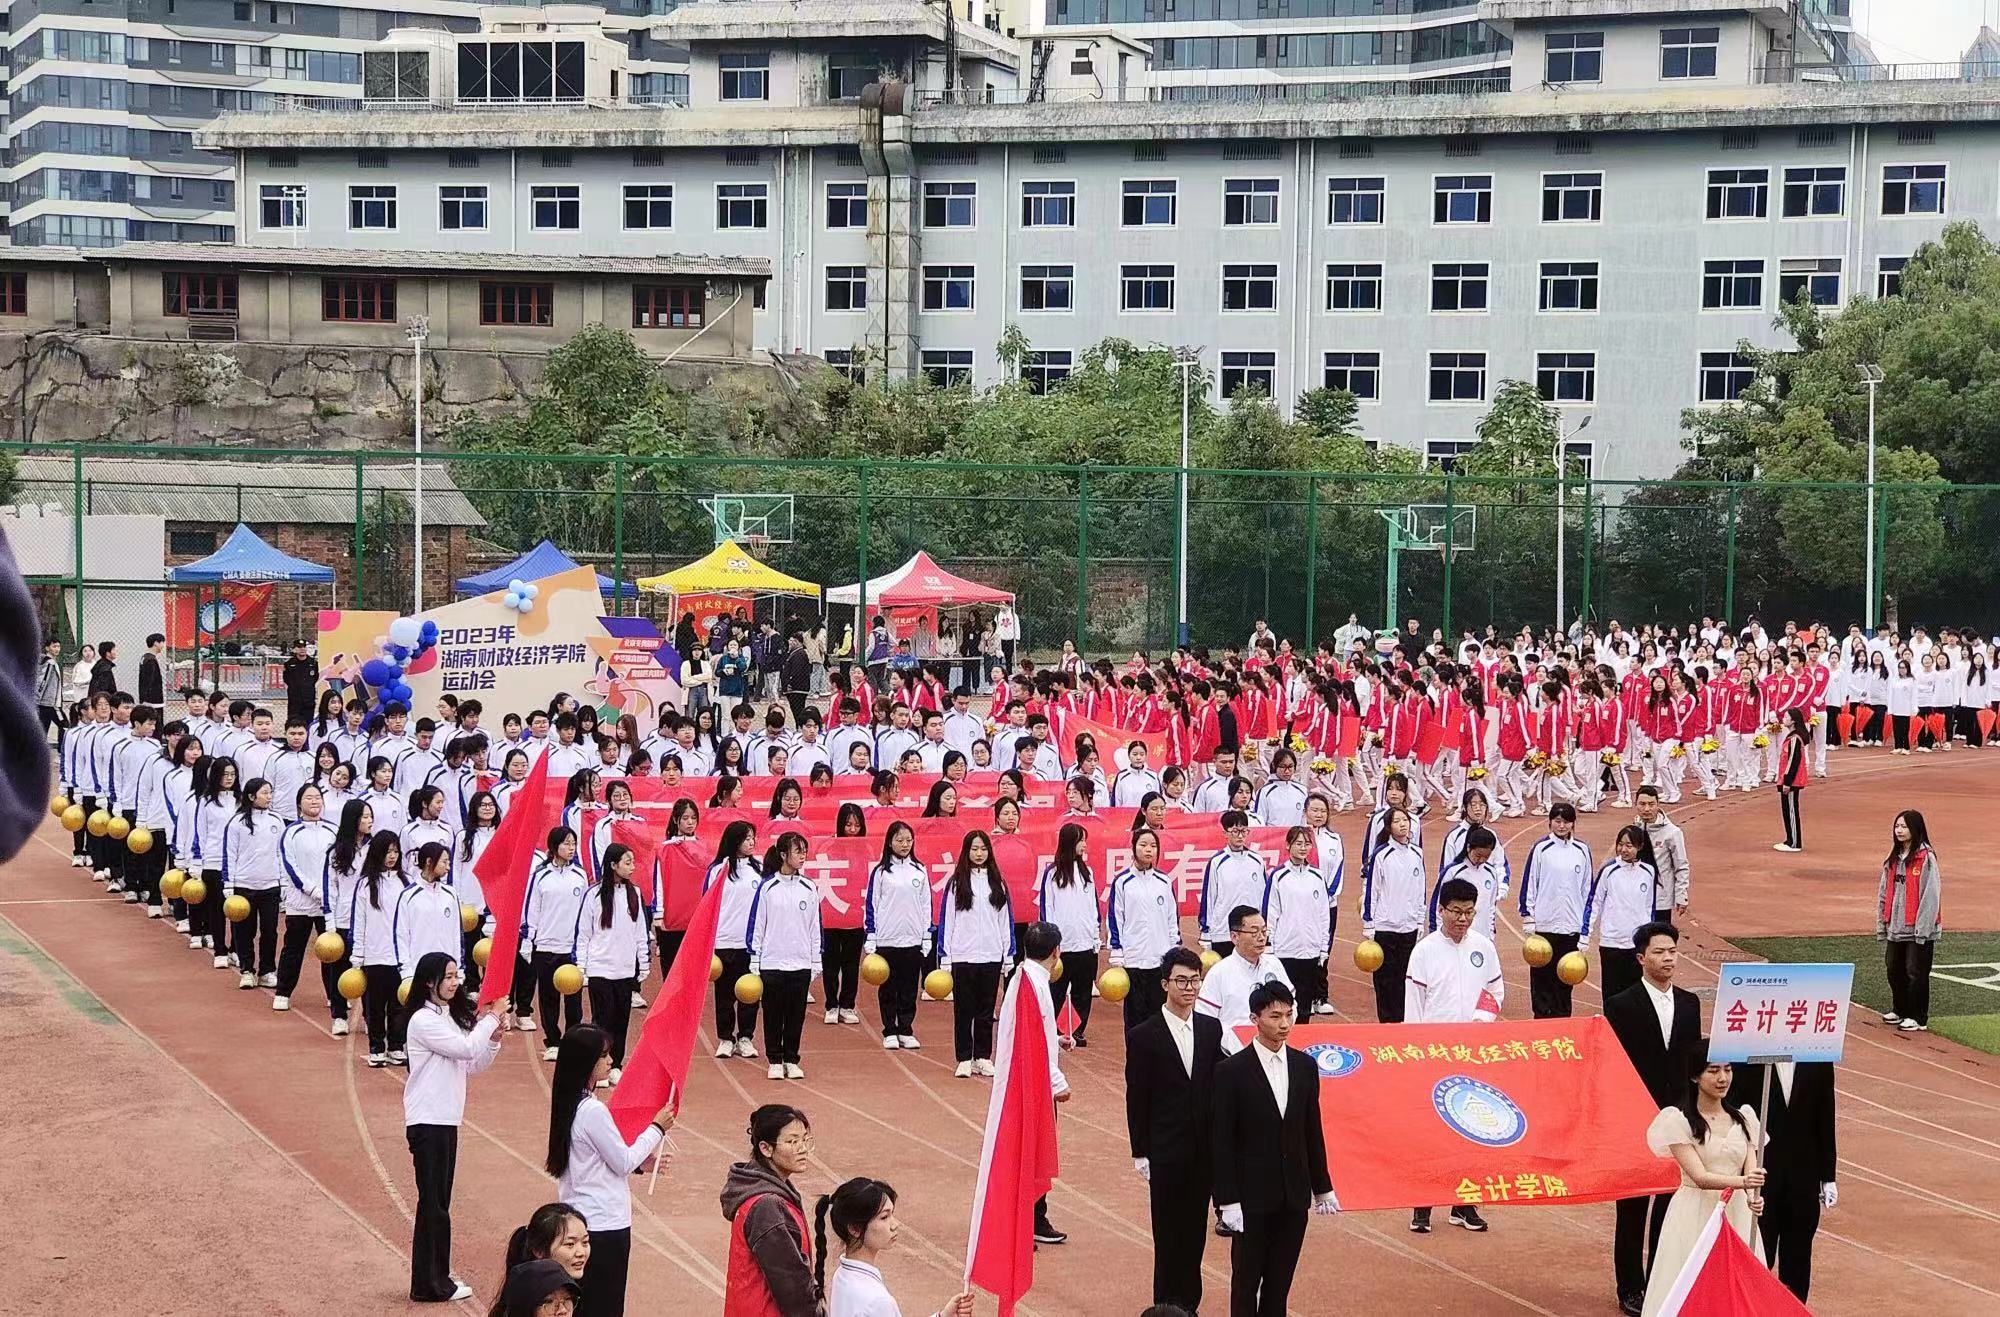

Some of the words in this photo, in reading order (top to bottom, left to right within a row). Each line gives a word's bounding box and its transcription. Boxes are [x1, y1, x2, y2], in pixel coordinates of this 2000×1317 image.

[440, 625, 516, 645] 2023年
[440, 643, 587, 669] 湖南财政经济学院
[442, 669, 496, 692] 运动会
[1726, 999, 1838, 1034] 会计学院
[1369, 1035, 1584, 1065] 湖南财政经济学院
[1454, 1172, 1571, 1204] 会计学院
